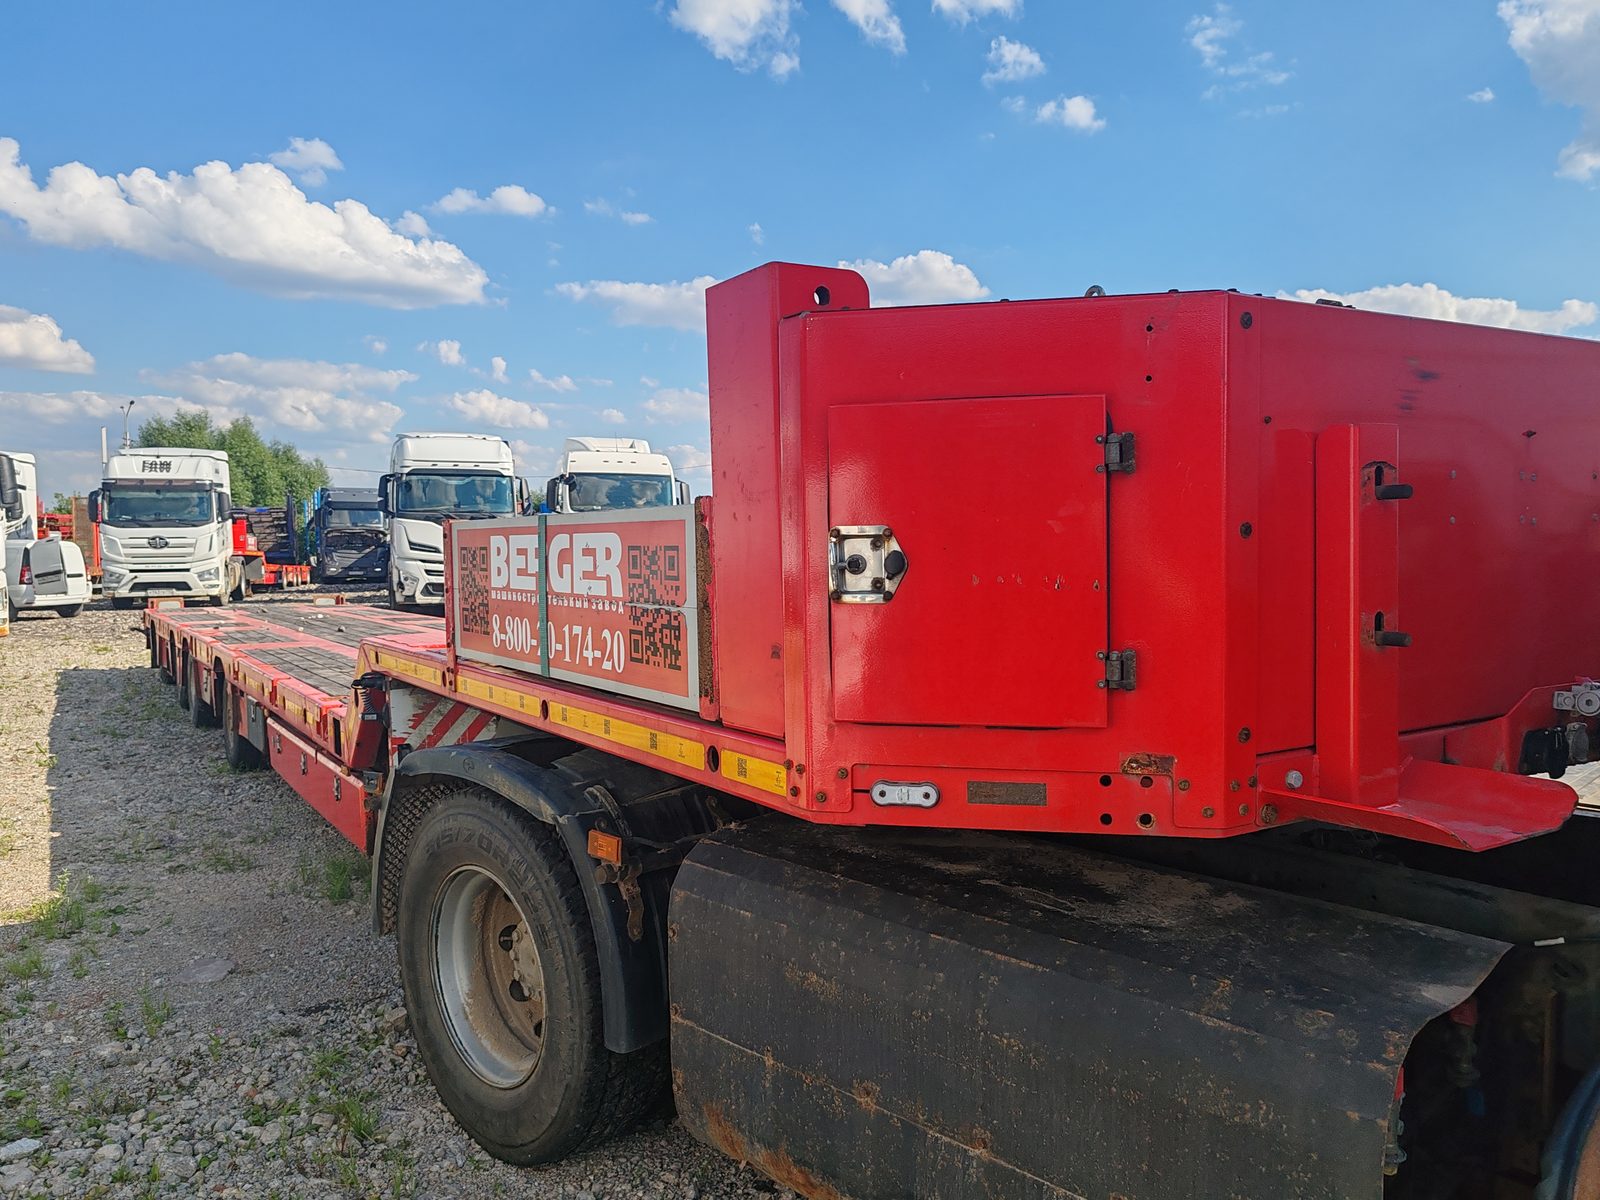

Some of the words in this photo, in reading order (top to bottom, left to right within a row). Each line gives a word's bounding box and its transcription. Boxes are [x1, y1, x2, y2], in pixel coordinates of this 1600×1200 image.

[142, 461, 172, 473] FAW
[491, 590, 589, 609] машиностртельный
[591, 598, 624, 614] завод
[492, 614, 625, 673] 8-800-0-174-20
